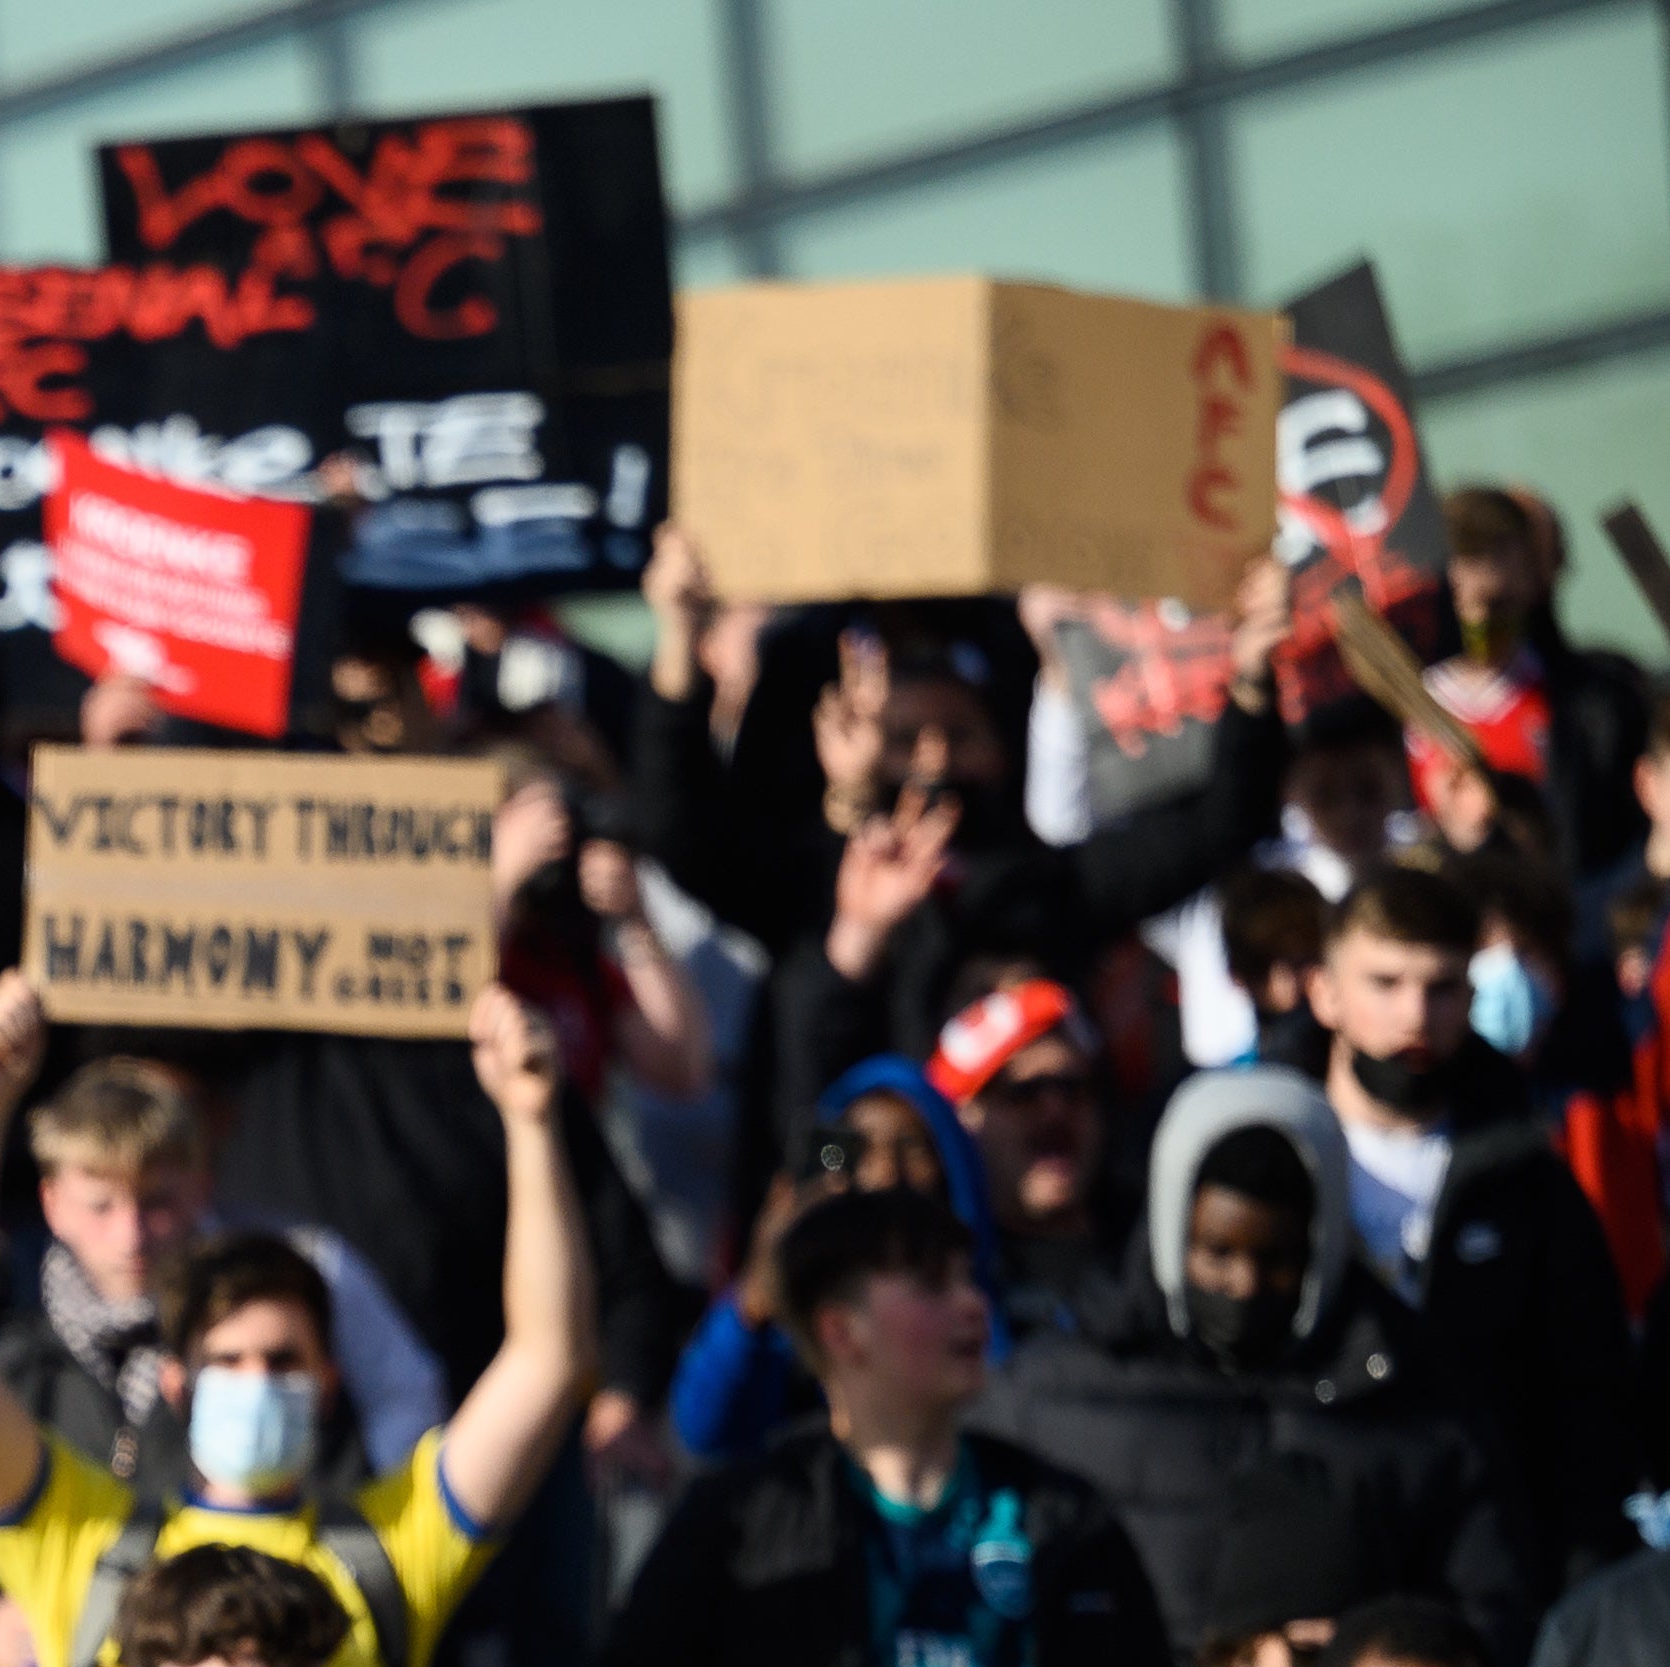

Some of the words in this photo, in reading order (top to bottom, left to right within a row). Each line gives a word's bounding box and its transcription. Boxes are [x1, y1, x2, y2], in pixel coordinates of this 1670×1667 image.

[118, 116, 543, 249] LOVE
[31, 793, 277, 862] VICTORY
[289, 797, 493, 866] THROUGH
